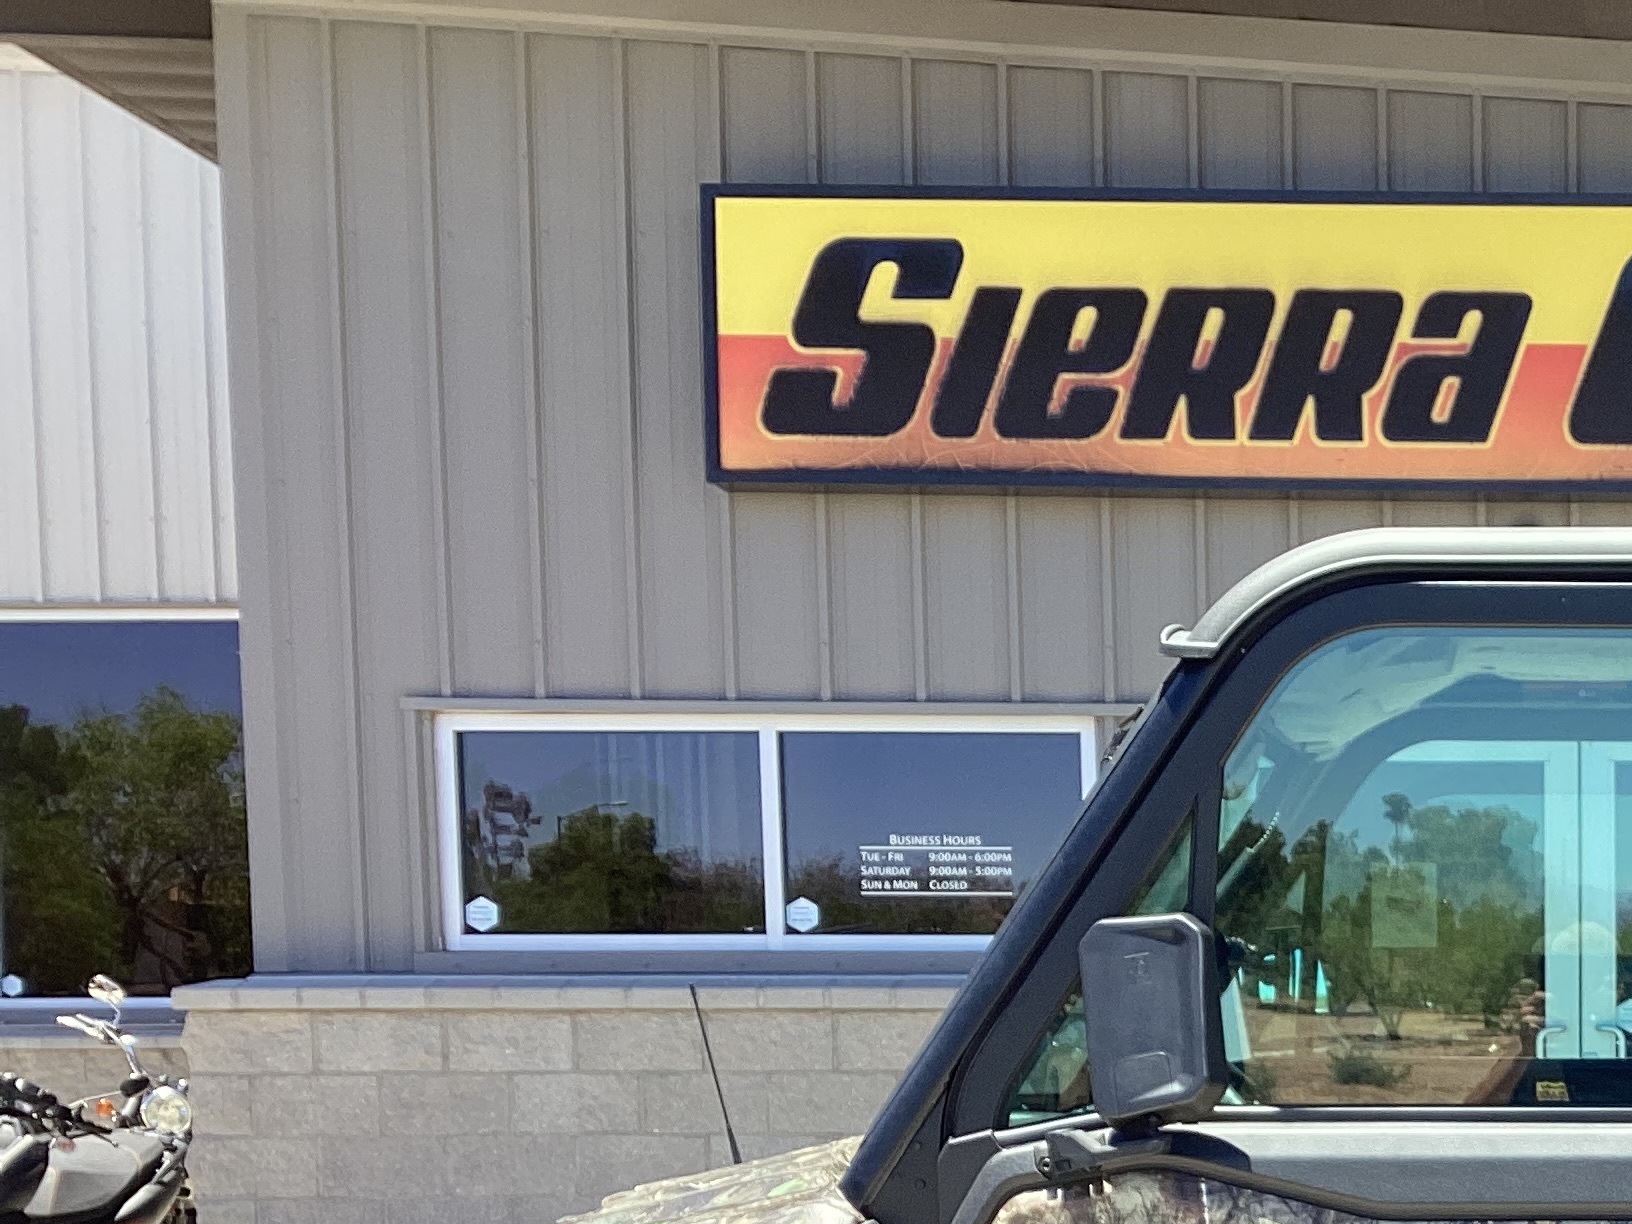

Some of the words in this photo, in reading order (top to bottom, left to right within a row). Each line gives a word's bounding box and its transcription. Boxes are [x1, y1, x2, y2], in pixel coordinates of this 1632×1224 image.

[889, 834, 940, 845] BUSINESS
[943, 834, 981, 845] HOURS
[861, 852, 880, 862] TUE
[888, 852, 904, 862] FRI
[928, 852, 967, 862] 9:00AM
[974, 852, 1012, 862] 6:00PM
[861, 866, 911, 876] SATURDAY
[928, 866, 967, 876] 9:00AM
[975, 866, 1012, 876] 5:00PM
[861, 880, 882, 890] SUN
[884, 881, 891, 890] &
[893, 880, 918, 890] MON
[929, 880, 968, 890] CLOSED
